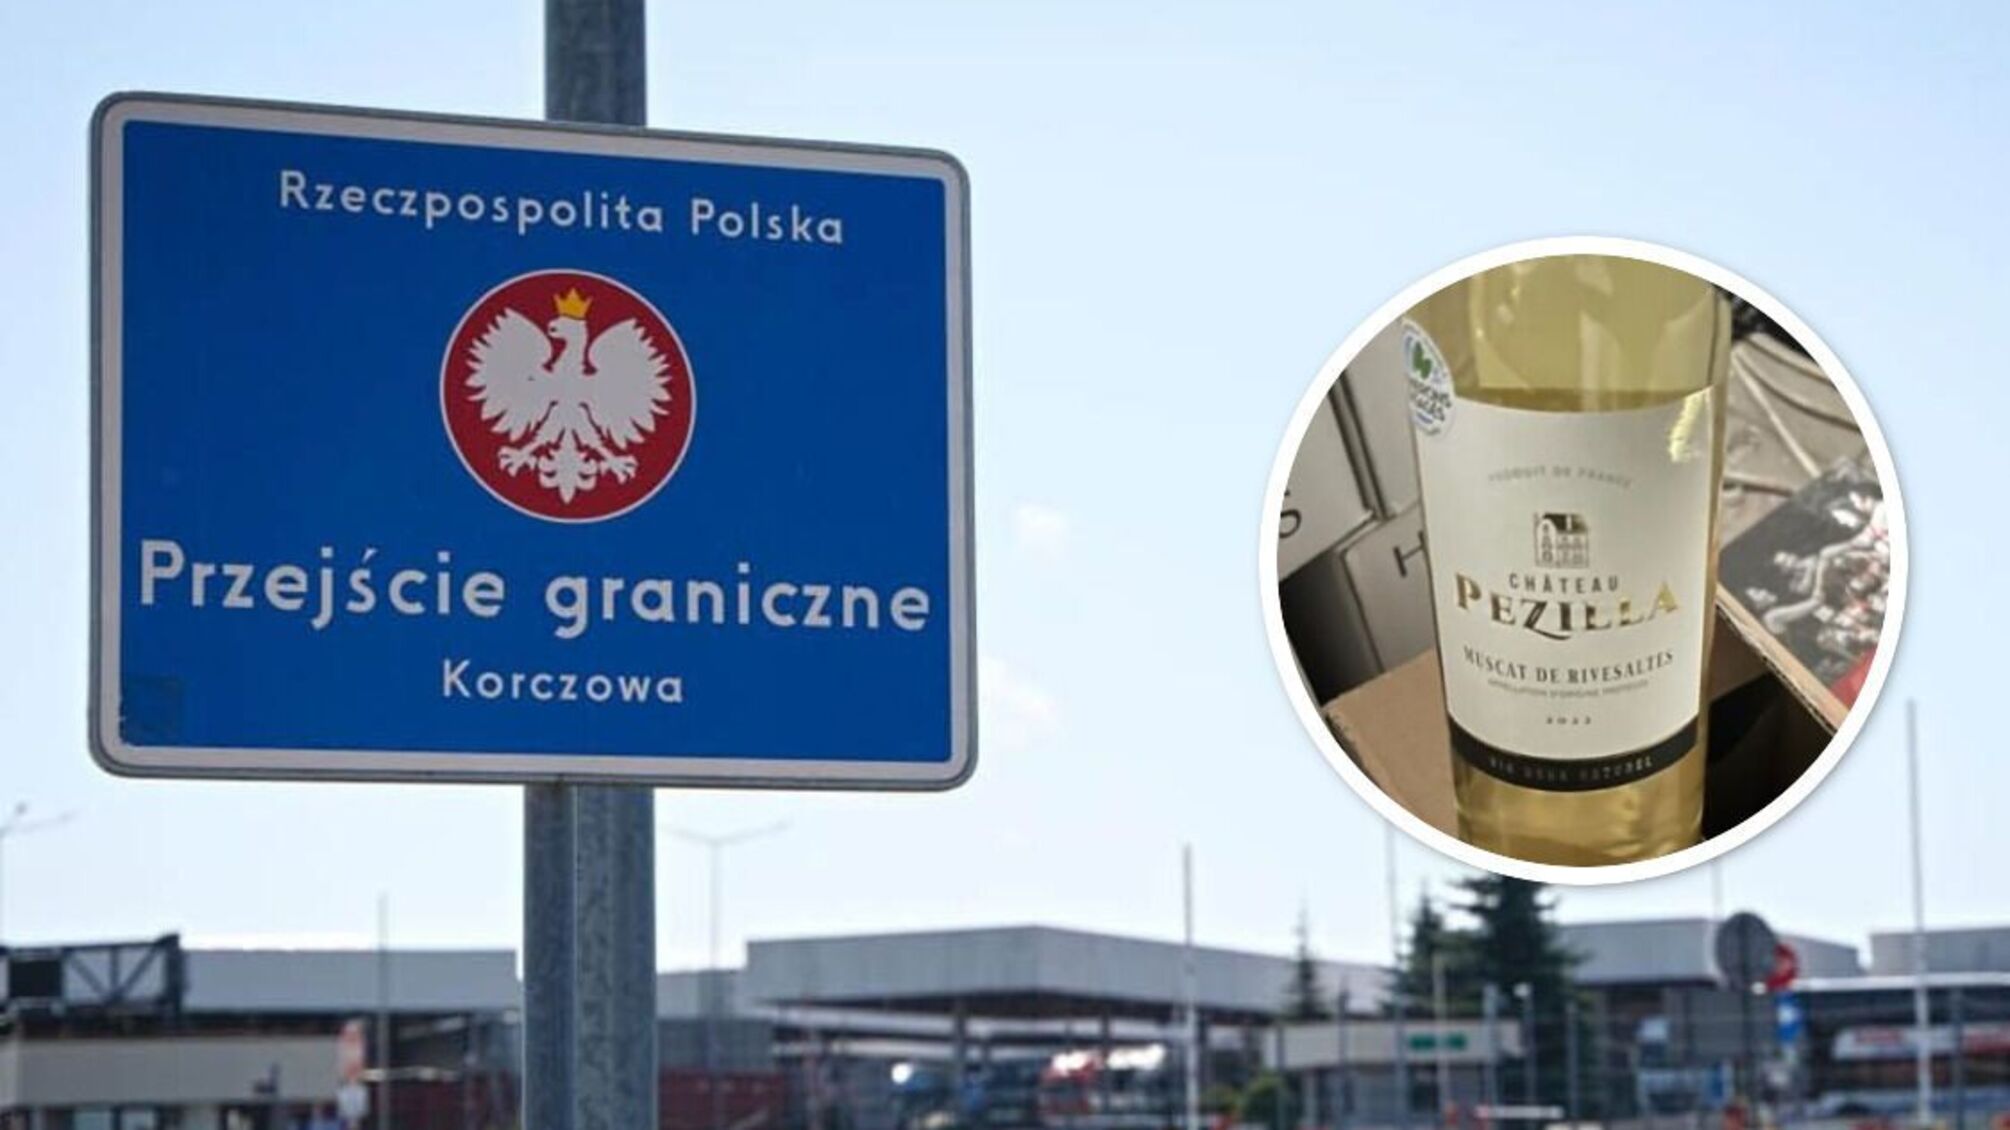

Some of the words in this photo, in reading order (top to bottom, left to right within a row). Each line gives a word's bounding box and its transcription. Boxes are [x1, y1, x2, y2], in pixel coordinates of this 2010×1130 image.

[280, 171, 663, 234] Rzeczpospolita
[691, 199, 843, 244] Polska
[141, 539, 506, 630] Przejście
[544, 562, 931, 640] graniczne
[1455, 572, 1680, 642] PEZILLA
[1508, 572, 1620, 595] CHÂTEAU
[443, 659, 684, 703] Korczowa
[1463, 645, 1528, 681] MUSCAT
[1535, 666, 1559, 684] DE
[1566, 650, 1675, 685] RIVESALTES
